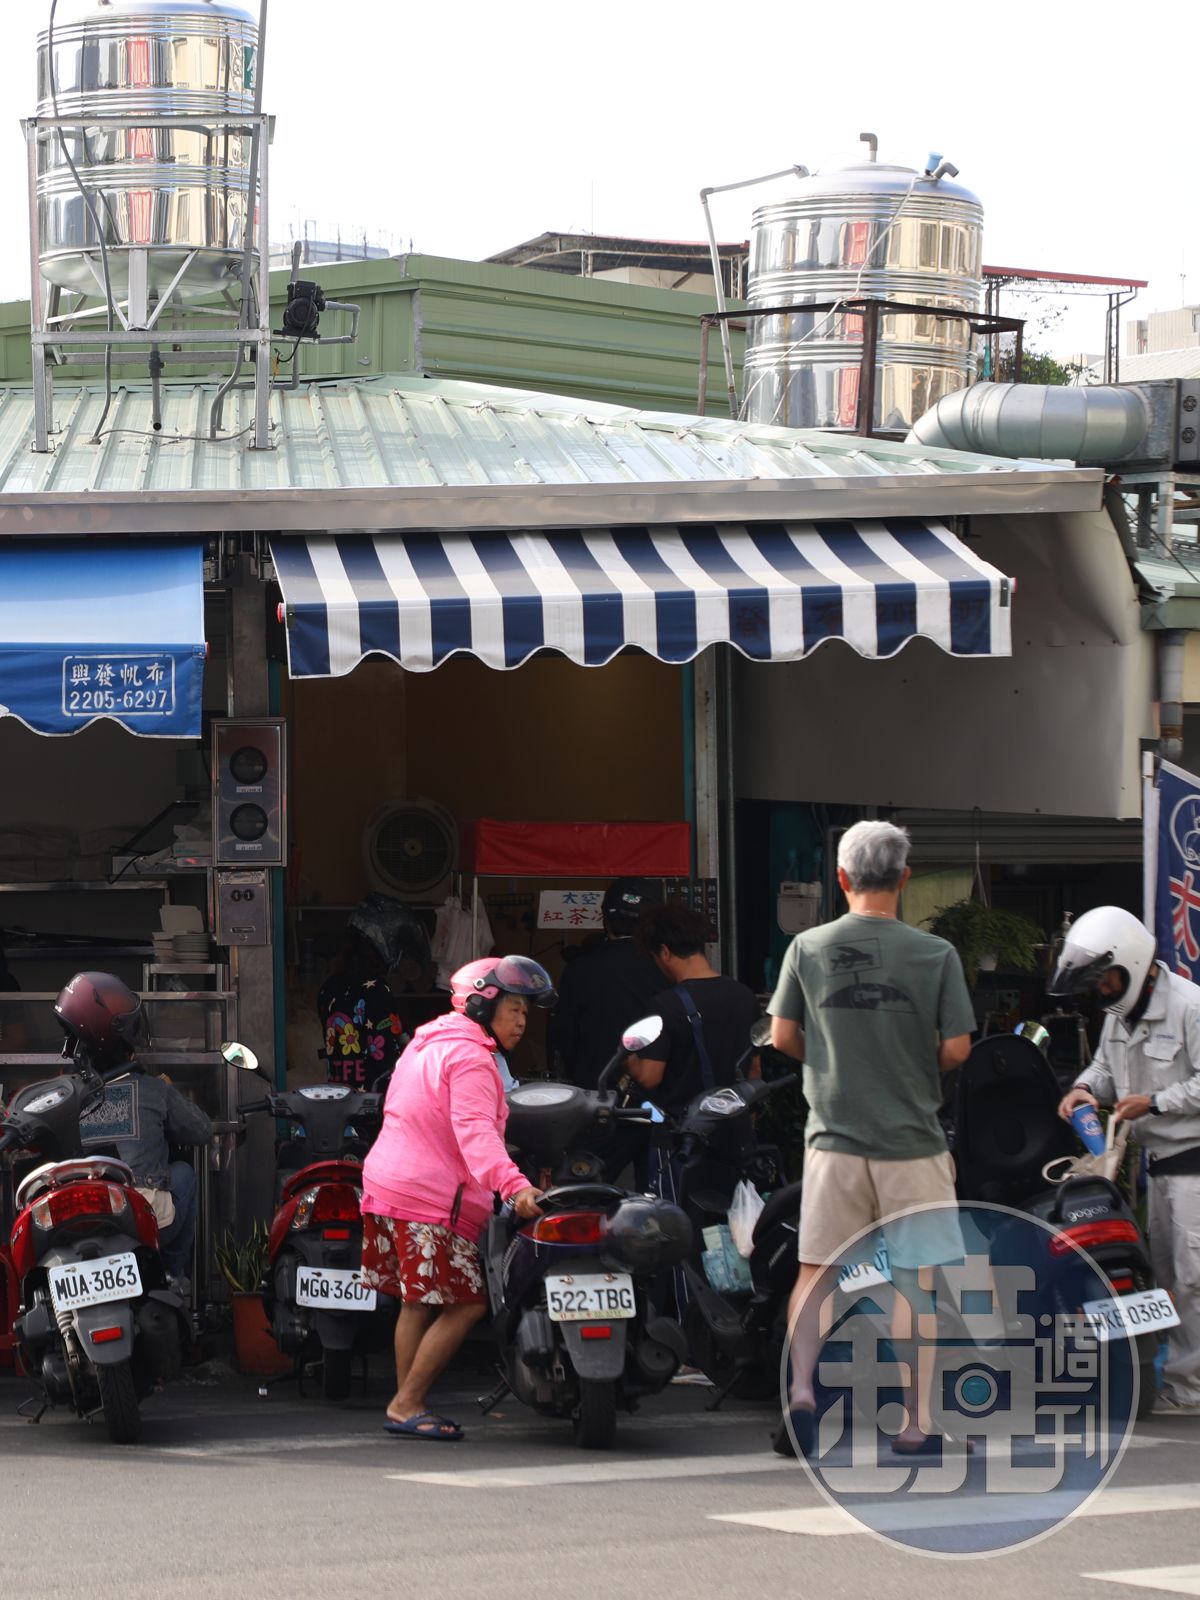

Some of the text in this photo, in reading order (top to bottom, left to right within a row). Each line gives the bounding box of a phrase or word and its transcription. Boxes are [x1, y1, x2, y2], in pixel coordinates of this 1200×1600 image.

[70, 662, 164, 688] 興發帆布
[70, 689, 168, 709] 2205-6297
